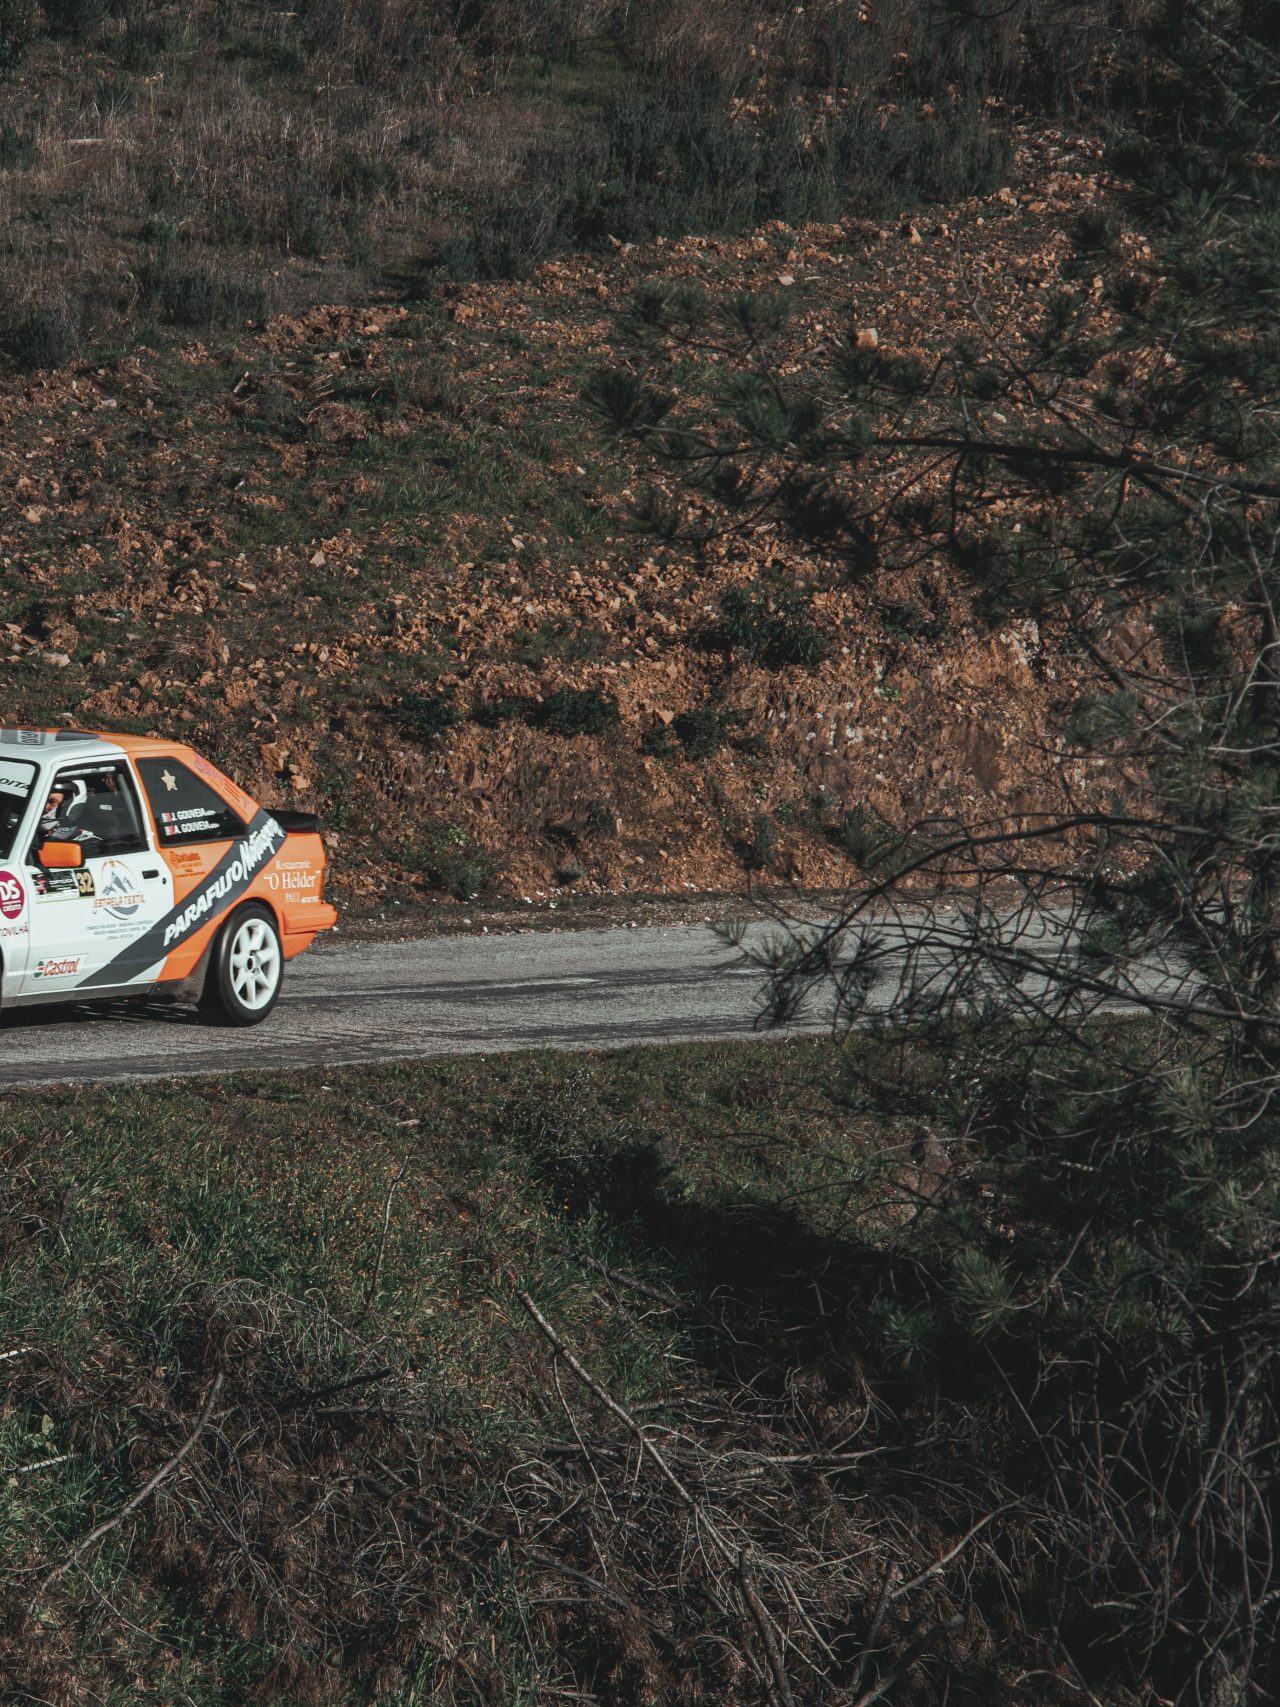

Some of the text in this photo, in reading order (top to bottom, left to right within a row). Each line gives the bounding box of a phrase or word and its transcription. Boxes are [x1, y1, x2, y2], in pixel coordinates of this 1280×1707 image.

[177, 807, 206, 820] GOUVEIA
[181, 820, 210, 833] GOUVEIA
[75, 871, 95, 894] 32
[163, 860, 243, 947] PARAFUSO
[43, 957, 81, 977] Castrol
